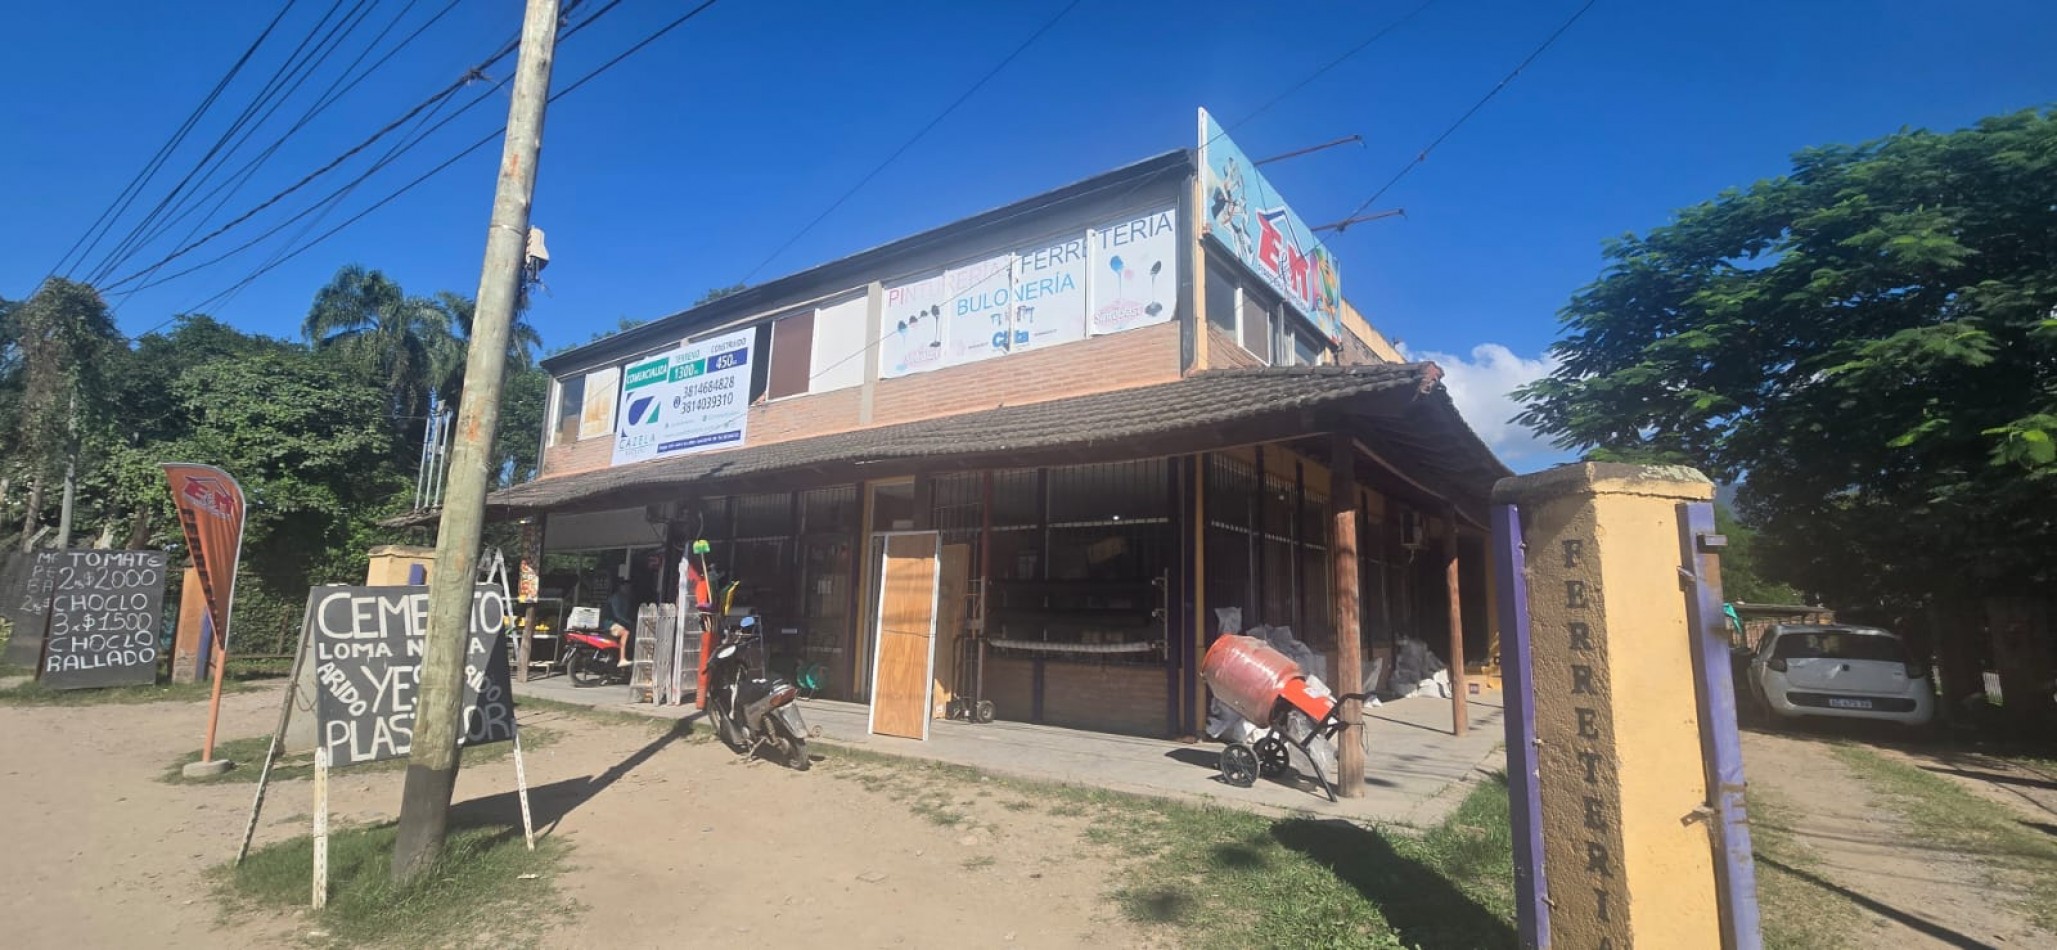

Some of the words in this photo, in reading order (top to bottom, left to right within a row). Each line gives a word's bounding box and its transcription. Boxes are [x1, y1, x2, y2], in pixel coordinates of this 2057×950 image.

[67, 552, 163, 568] TOMATE
[53, 593, 148, 613] CHOCLO
[318, 590, 505, 640] CEMETO
[48, 630, 154, 653] CHOCLO
[318, 642, 393, 661] LOMA
[46, 648, 156, 673] RALLADO
[317, 661, 367, 717] ARIDO
